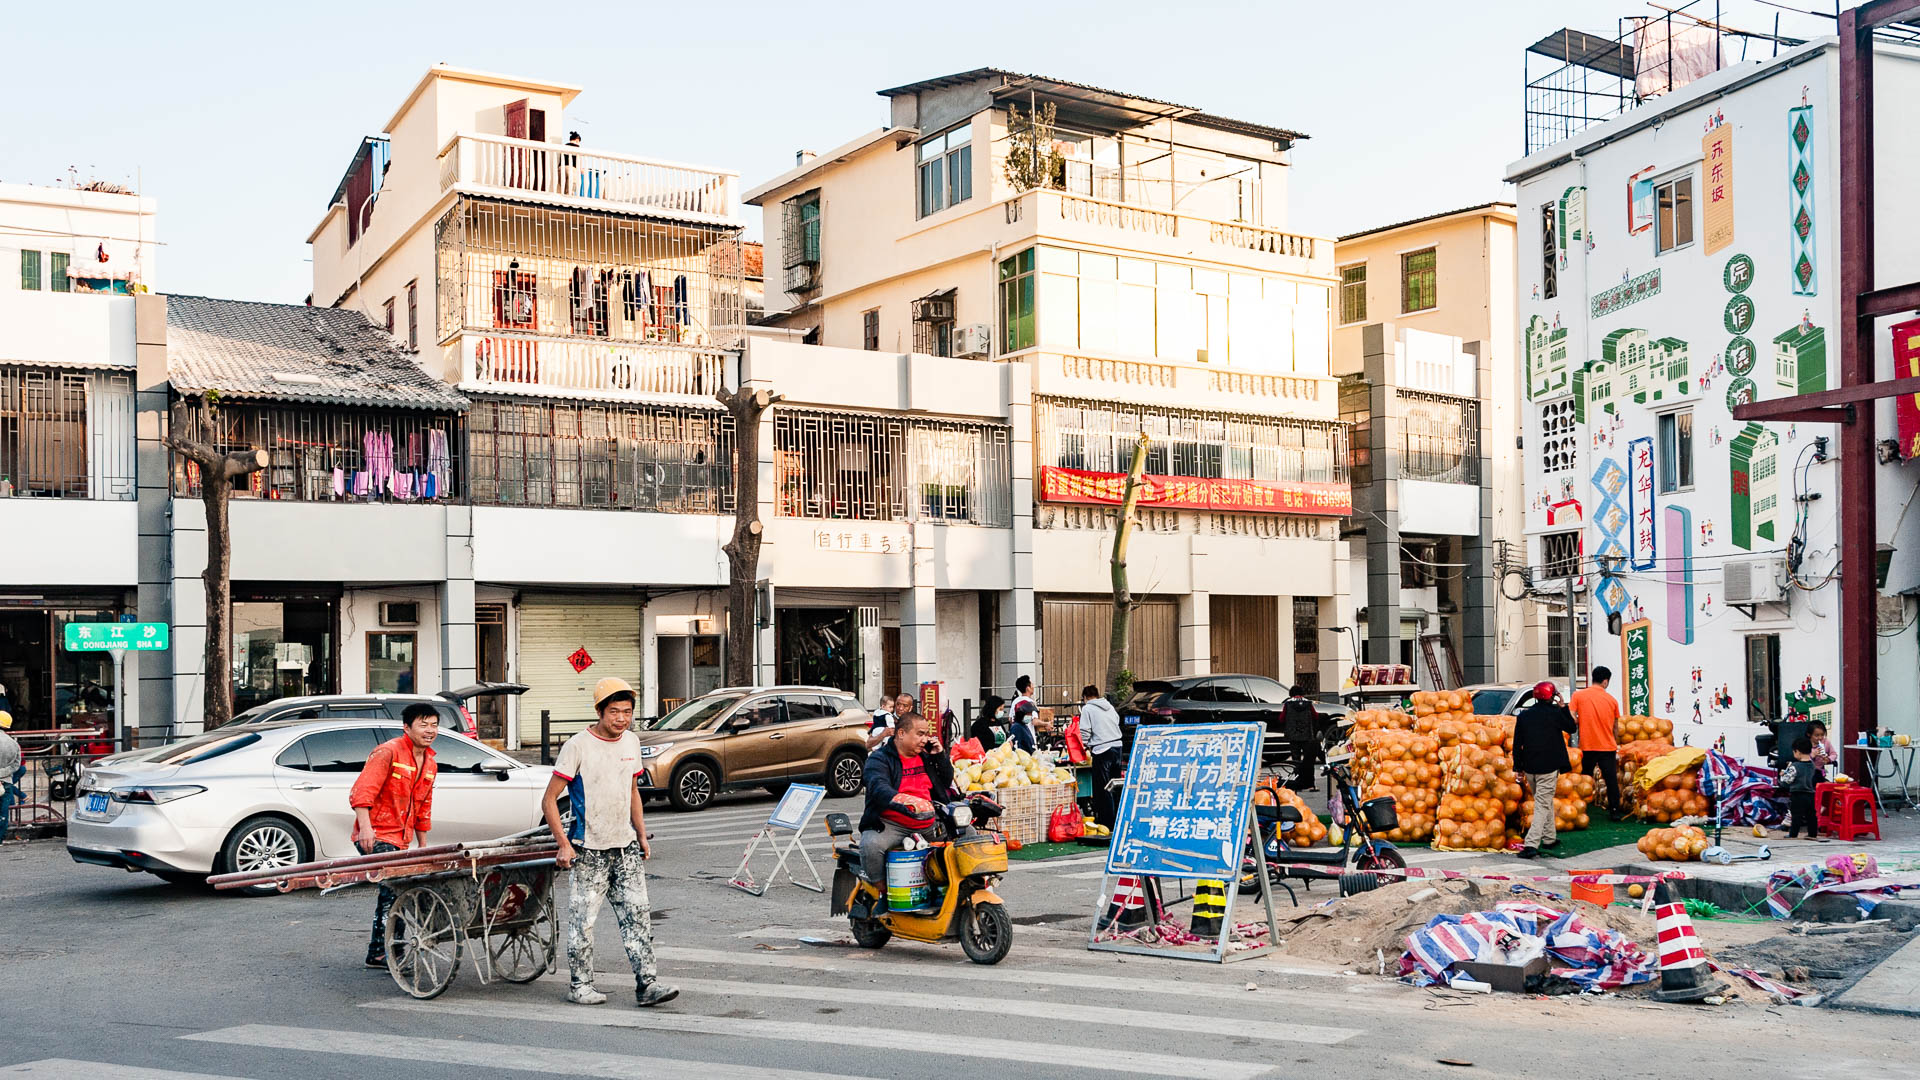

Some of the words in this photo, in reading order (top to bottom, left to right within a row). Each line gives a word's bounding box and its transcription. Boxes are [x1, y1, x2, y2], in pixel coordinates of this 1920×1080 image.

[1637, 448, 1654, 552] 龙华大鼓
[78, 625, 157, 639] 东江沙
[83, 641, 128, 649] DONGJIANG
[136, 640, 152, 649] SHA
[924, 687, 938, 736] 自行车
[1139, 762, 1242, 785] 施工前方路
[1135, 788, 1239, 812] 口禁止左转
[1148, 815, 1233, 840] 请绕道通
